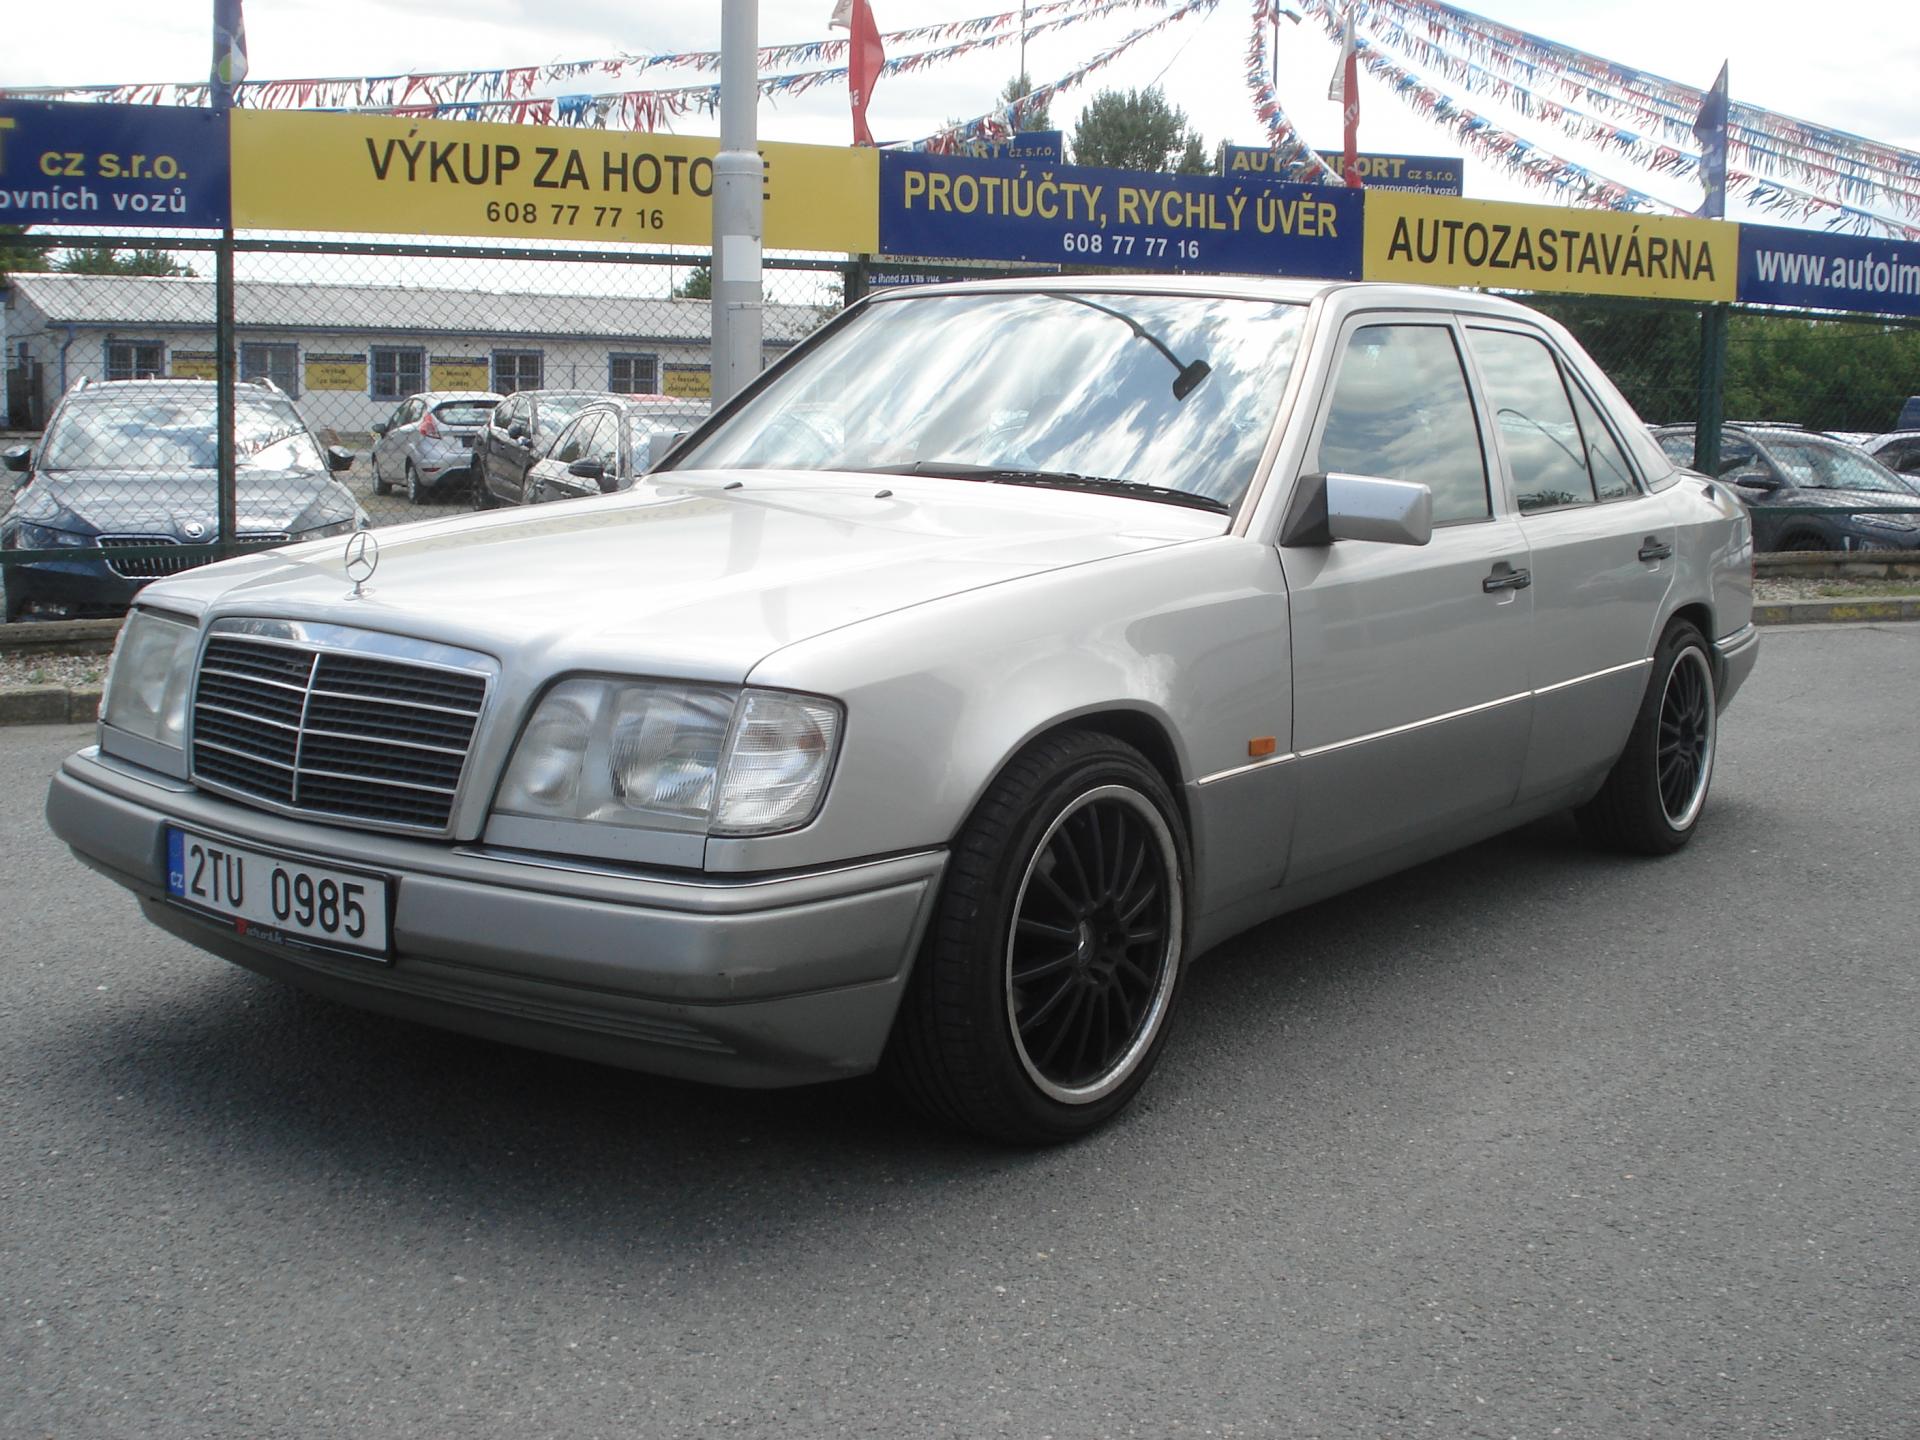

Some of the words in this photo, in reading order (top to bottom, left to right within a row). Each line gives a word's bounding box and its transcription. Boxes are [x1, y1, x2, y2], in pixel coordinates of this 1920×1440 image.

[40, 151, 85, 176] cz
[98, 152, 187, 180] s.r.o.
[366, 129, 520, 186] VÝKUP
[533, 146, 590, 191] ZA
[1424, 169, 1457, 182] s.r.o.
[112, 186, 187, 213] vozů
[904, 170, 1107, 229] PROTIÚČTY,
[1118, 186, 1246, 232] RYCHLÝ
[1256, 186, 1339, 238] ÚVĚR
[486, 201, 538, 224] 608
[551, 203, 580, 226] 77
[594, 206, 622, 228] 77
[636, 208, 664, 230] 16
[1063, 232, 1103, 254] 608
[1112, 235, 1135, 255] 77
[1145, 237, 1168, 257] 77
[1178, 239, 1200, 259] 16
[1387, 215, 1716, 282] AUTOZASTAVÁRNA
[1755, 249, 1920, 296] www.autoim
[170, 870, 184, 889] CZ
[190, 843, 244, 908] 2TU
[271, 867, 366, 939] 0985
